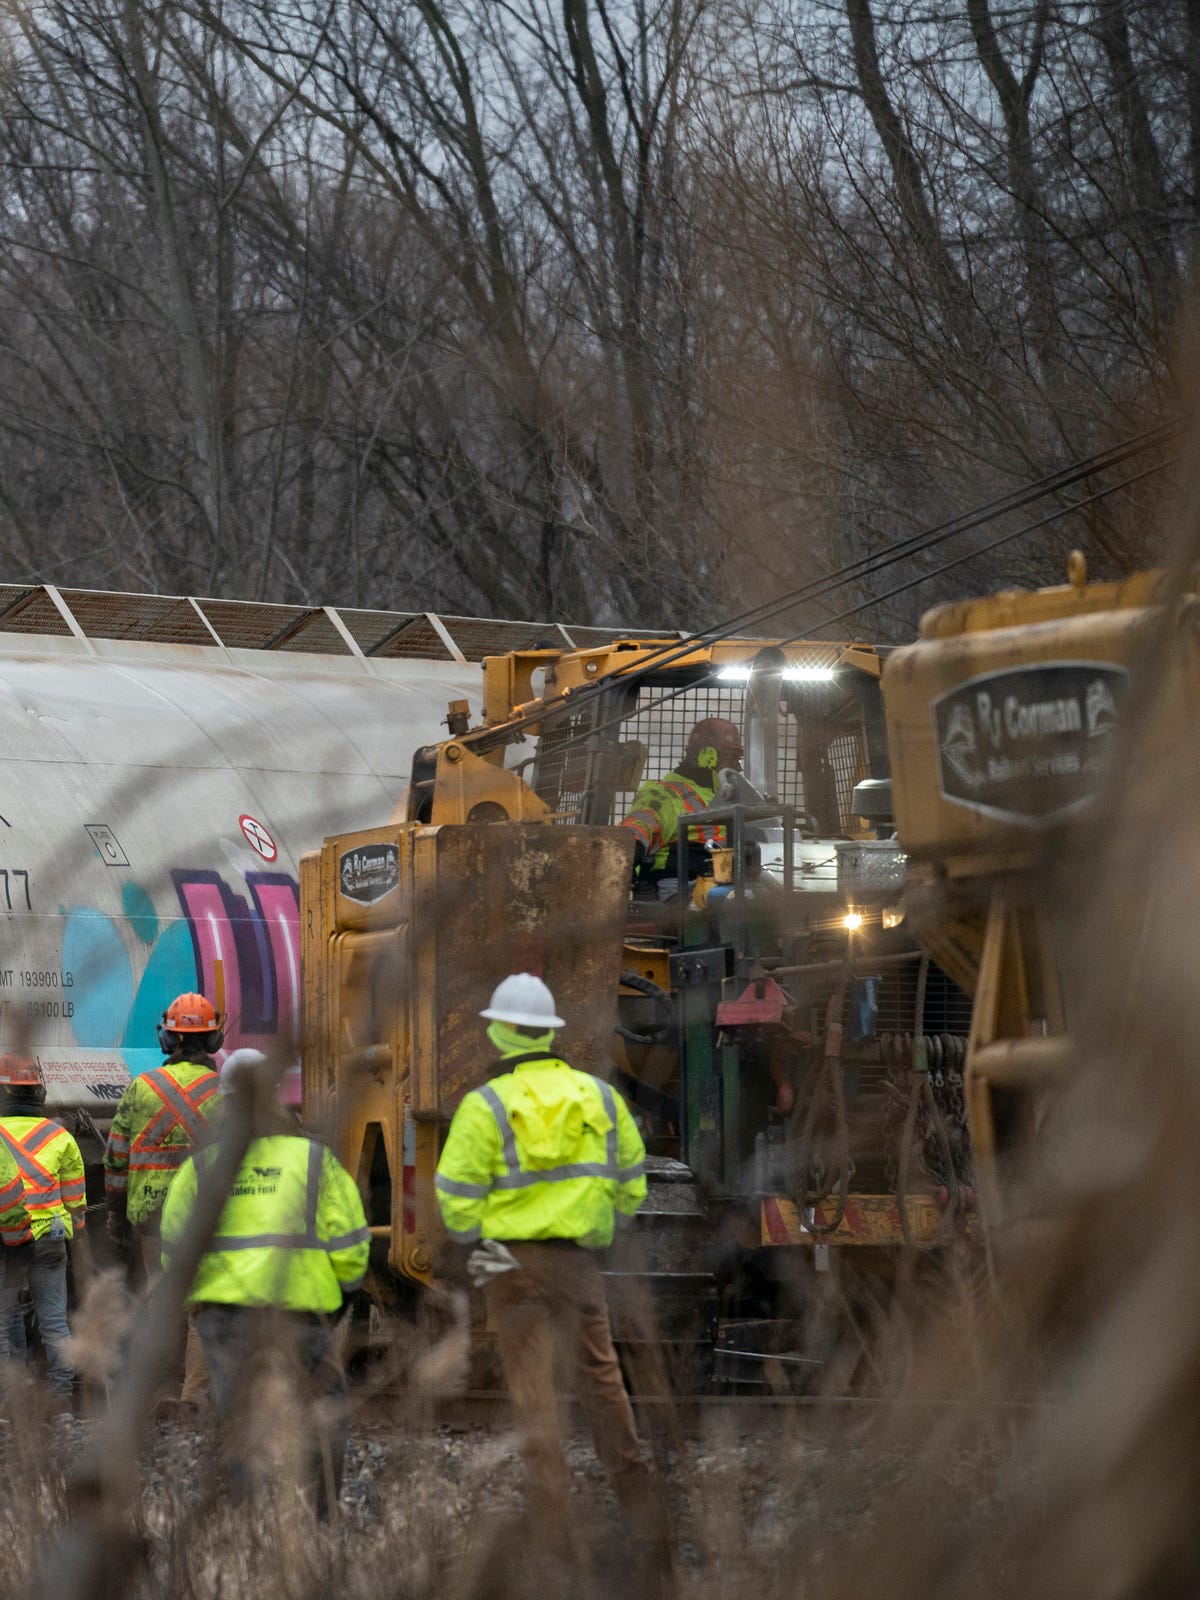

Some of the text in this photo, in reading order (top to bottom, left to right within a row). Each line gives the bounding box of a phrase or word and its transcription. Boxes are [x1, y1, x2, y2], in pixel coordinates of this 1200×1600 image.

[1004, 696, 1082, 741] Corman
[105, 842, 117, 858] C
[20, 971, 59, 988] 193900
[61, 971, 74, 988] LB
[62, 1002, 75, 1018] LB
